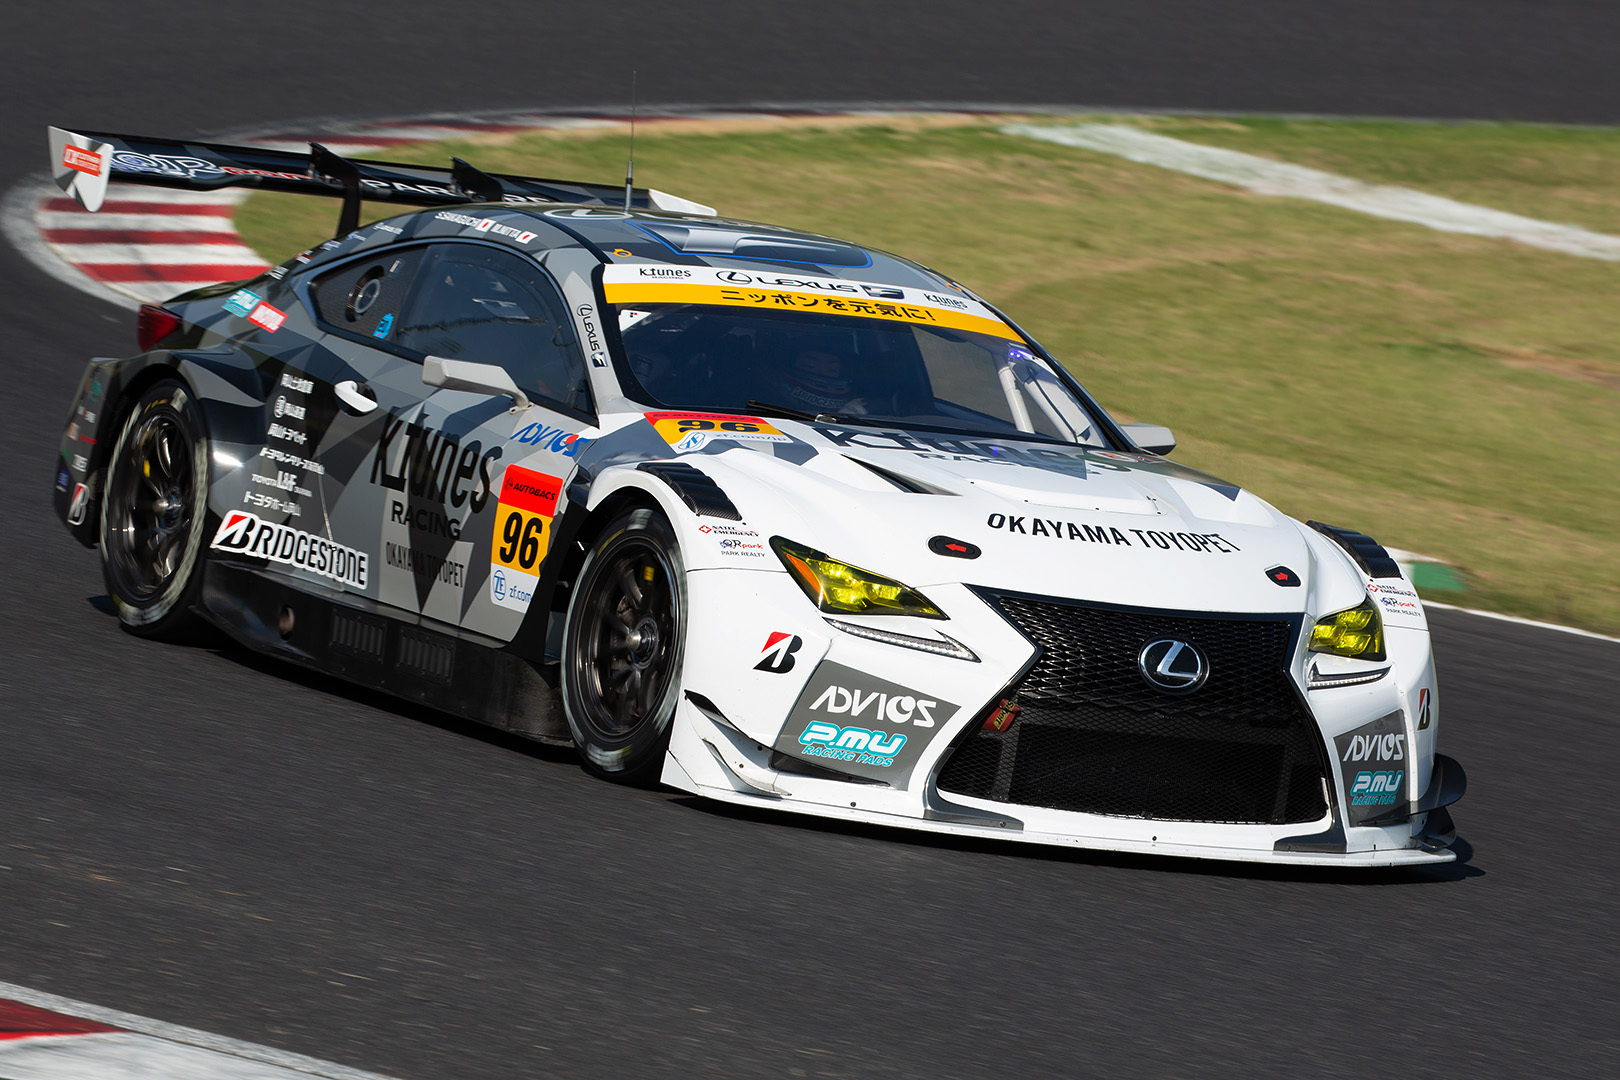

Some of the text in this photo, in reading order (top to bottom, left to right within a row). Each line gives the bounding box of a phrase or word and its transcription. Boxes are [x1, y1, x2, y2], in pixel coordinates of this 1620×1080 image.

[756, 276, 859, 293] LEXUS
[582, 315, 601, 352] LEXUS
[677, 419, 761, 434] 96
[512, 482, 557, 501] AUTOBACS
[391, 499, 461, 541] RACING
[986, 512, 1242, 553] OKAYAMA TOYOPET
[216, 514, 367, 586] BRIDGESTONE
[499, 511, 543, 570] 96
[808, 685, 937, 728] ADVICS
[801, 745, 895, 768] RACING PADS
[1342, 732, 1405, 762] ADVICS
